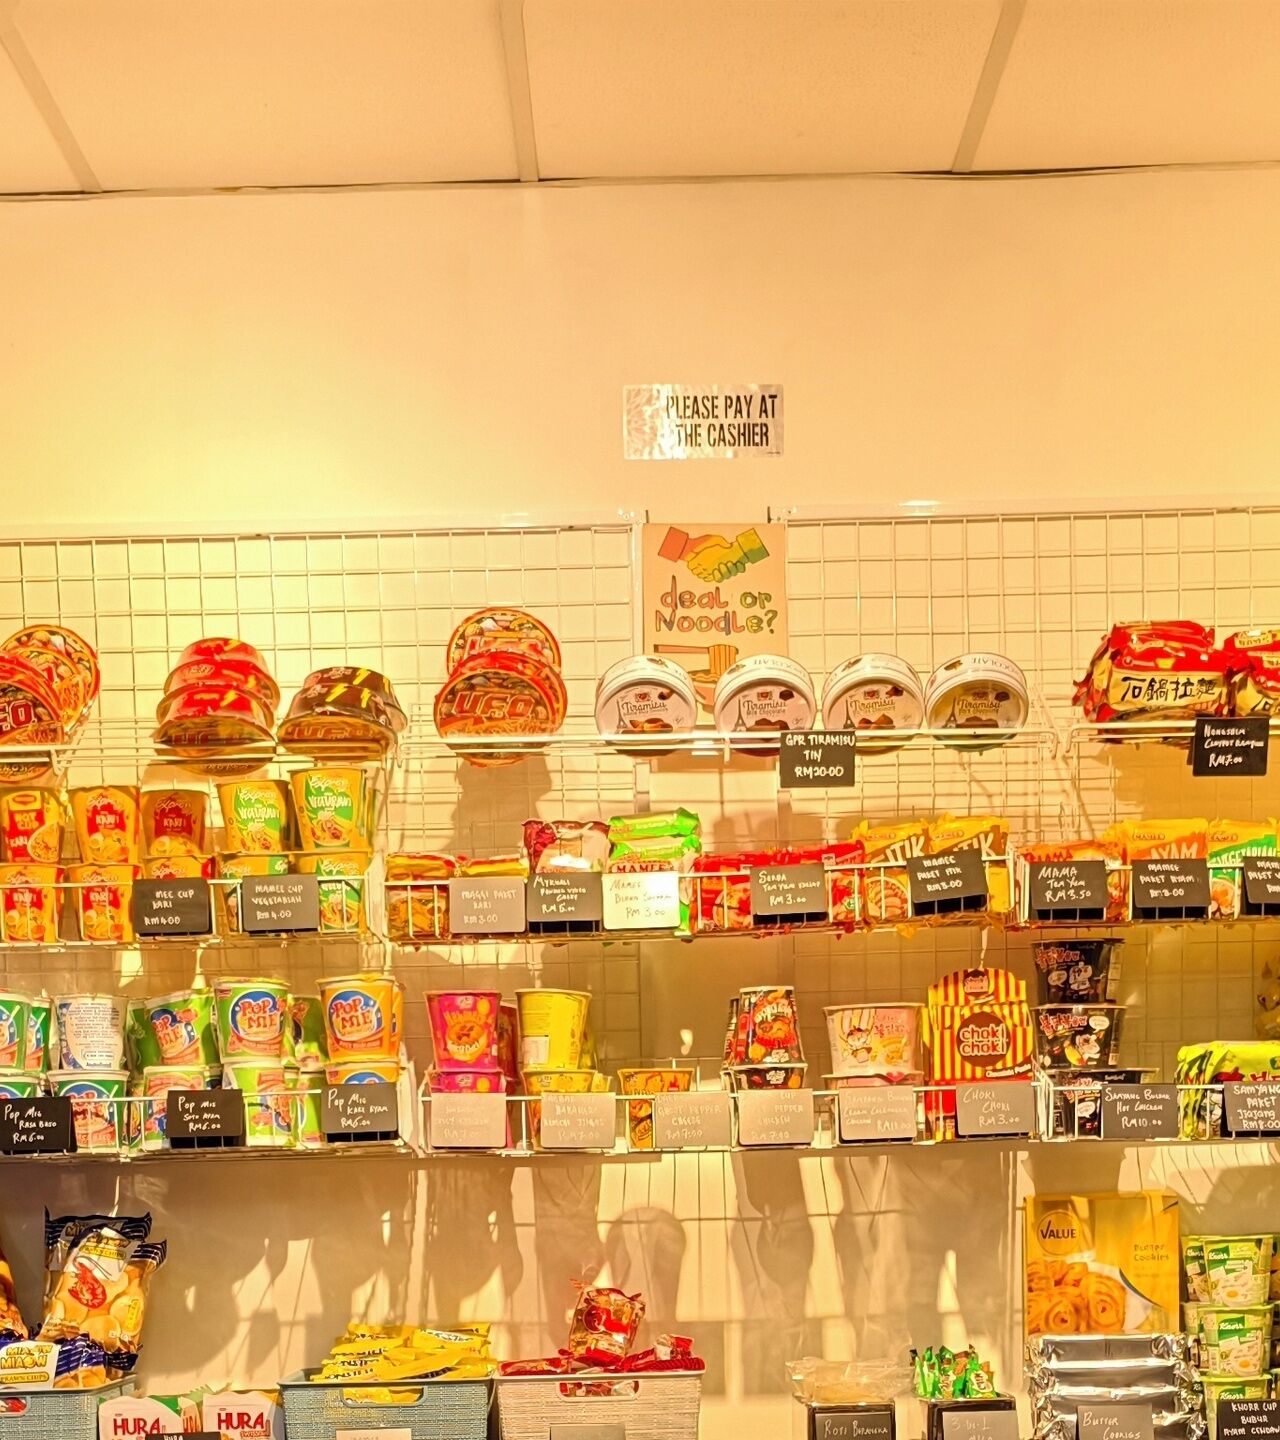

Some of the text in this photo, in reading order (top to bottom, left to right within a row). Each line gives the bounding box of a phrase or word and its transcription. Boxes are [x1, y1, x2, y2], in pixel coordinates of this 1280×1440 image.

[666, 394, 778, 419] PLEASE PAY AT
[675, 422, 769, 447] THE CASHIER
[661, 575, 772, 610] deal or
[656, 610, 778, 635] Noodle?
[621, 701, 667, 713] Tiramisu
[743, 700, 788, 710] Tiramisu
[850, 700, 896, 711] Tiramisu
[957, 700, 1002, 710] Tiramisu
[786, 734, 855, 746] GPR TIRAMISU
[804, 751, 822, 762] TIN
[1039, 867, 1077, 878] MAMA
[156, 890, 195, 899] MEE CUP
[288, 885, 303, 893] CUP
[240, 998, 268, 1015] POP
[332, 998, 363, 1016] POP
[246, 1014, 278, 1028] MIE
[340, 1013, 372, 1028] MIE
[963, 1088, 994, 1103] CHOKI
[983, 1101, 1009, 1113] CHOKI
[1247, 1097, 1277, 1107] PAKET
[1040, 1220, 1077, 1239] VALUE
[1219, 1320, 1244, 1330] Knorr
[1231, 1402, 1277, 1412] KNORR CUP
[218, 1412, 265, 1430] HURA
[1241, 1415, 1268, 1423] BUBUR
[113, 1415, 162, 1436] HURA
[1224, 1427, 1246, 1435] AYAM
